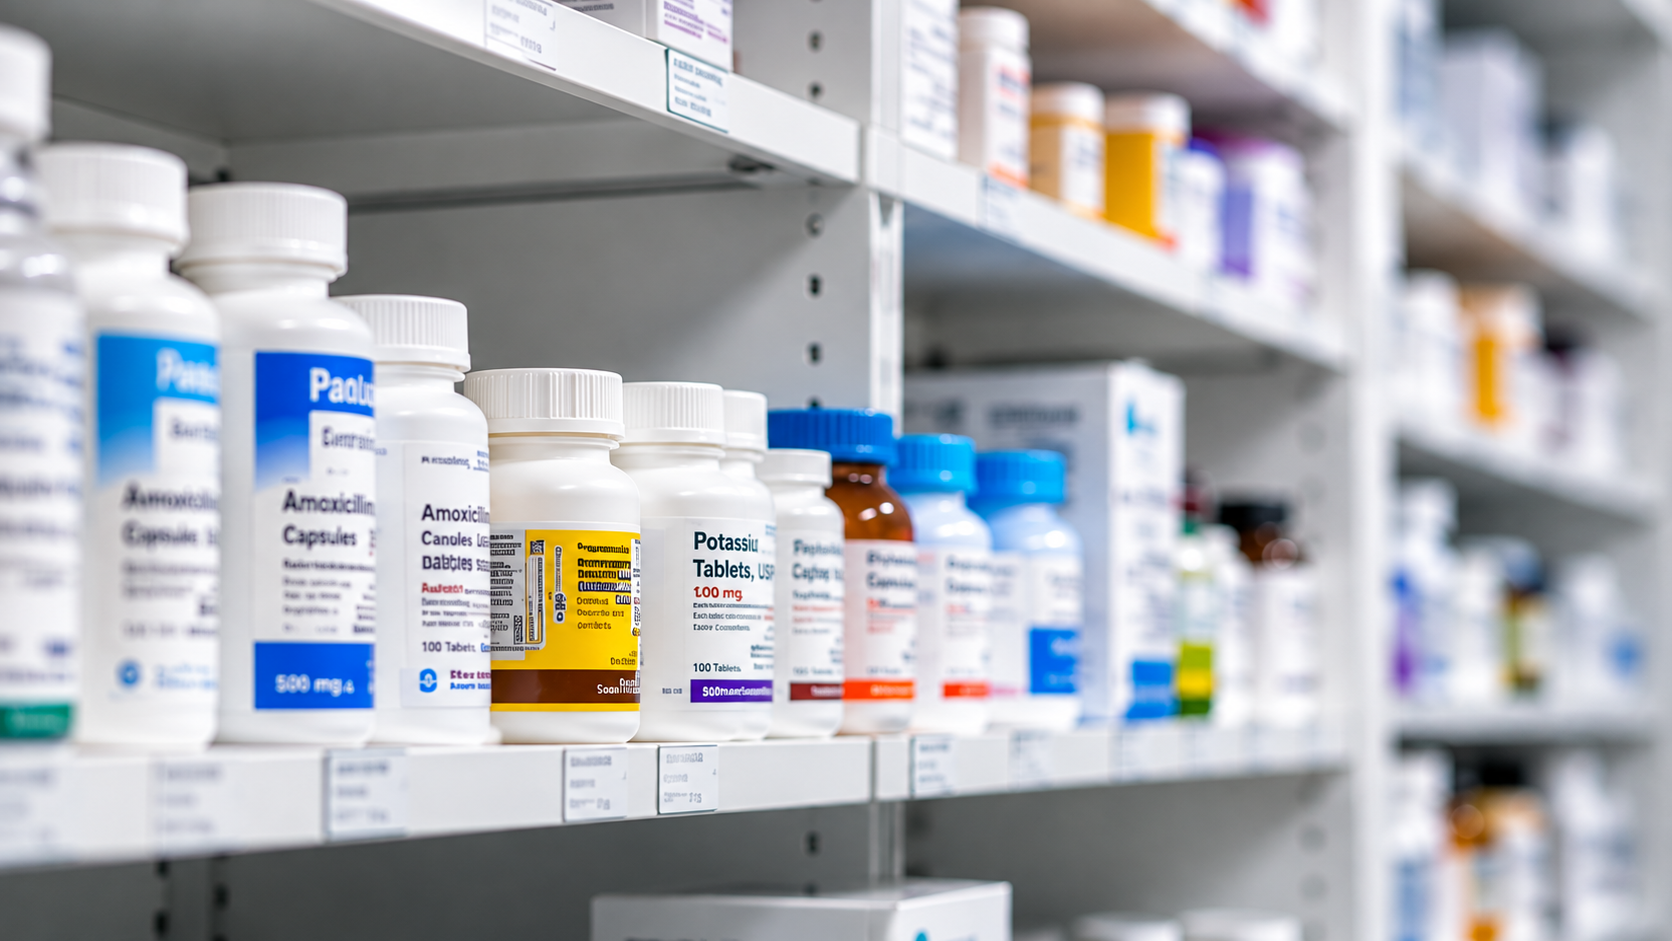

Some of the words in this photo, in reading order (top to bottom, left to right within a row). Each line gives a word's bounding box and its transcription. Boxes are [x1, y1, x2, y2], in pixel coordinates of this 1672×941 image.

[283, 524, 357, 550] Capsules
[692, 559, 755, 582] Tablets,
[722, 589, 743, 602] mg
[422, 641, 442, 653] 100
[693, 663, 712, 672] 100
